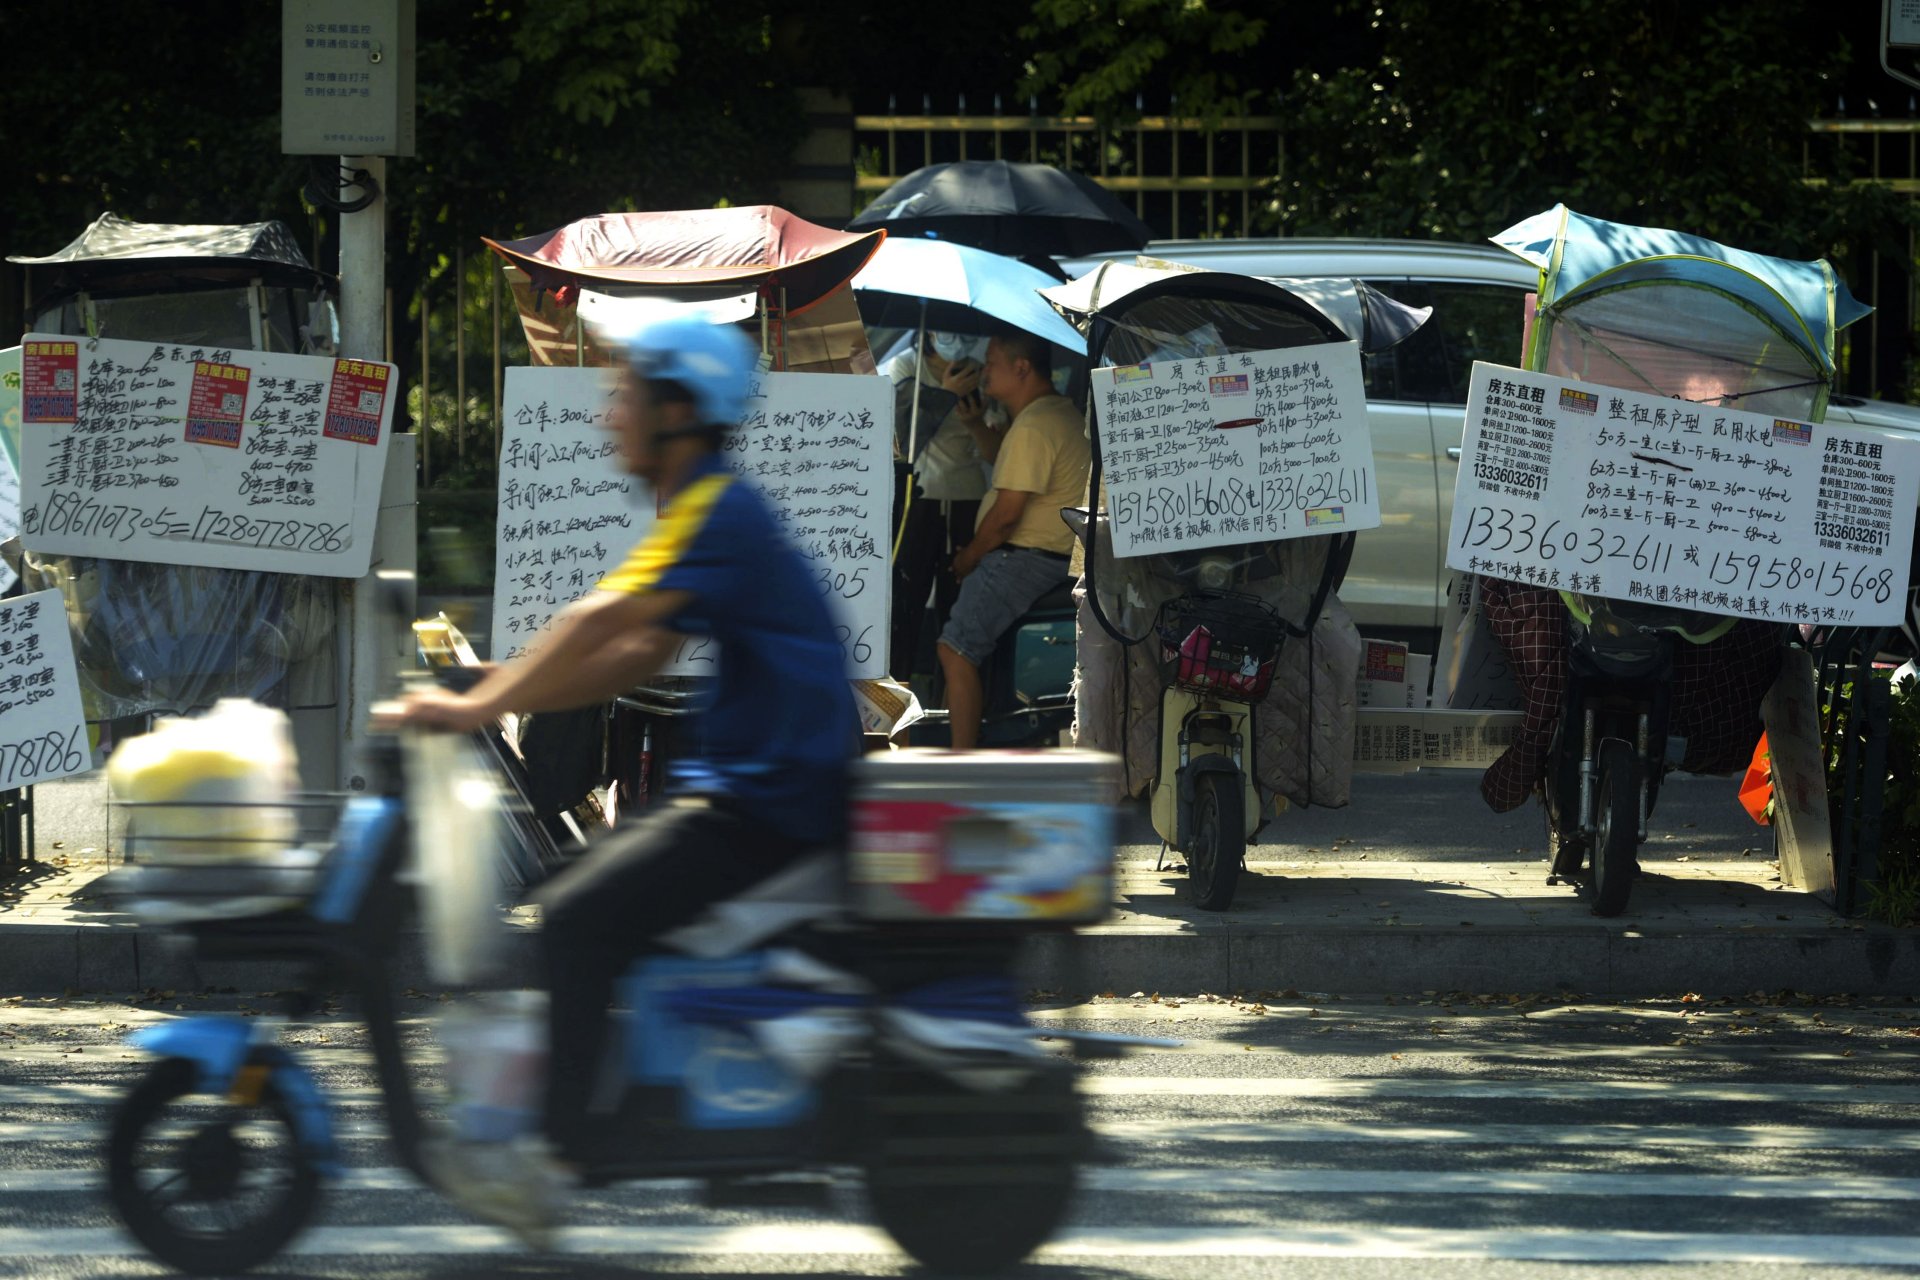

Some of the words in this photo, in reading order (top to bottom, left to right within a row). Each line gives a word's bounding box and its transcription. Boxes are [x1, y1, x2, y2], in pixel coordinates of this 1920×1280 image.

[337, 360, 387, 380] 房东直租
[1488, 378, 1546, 404] 房东直租
[1824, 437, 1883, 459] 房东直租
[1473, 462, 1548, 492] 13336032611
[1478, 480, 1500, 493] 同微信
[1504, 486, 1541, 501] 不收中介费
[1814, 521, 1890, 547] 13336032611
[1461, 506, 1672, 574] 13336032611
[1684, 545, 1700, 568] 或
[1709, 551, 1894, 604] 15958015608
[1820, 538, 1842, 550] 同微信
[1845, 542, 1883, 556] 不收中介费
